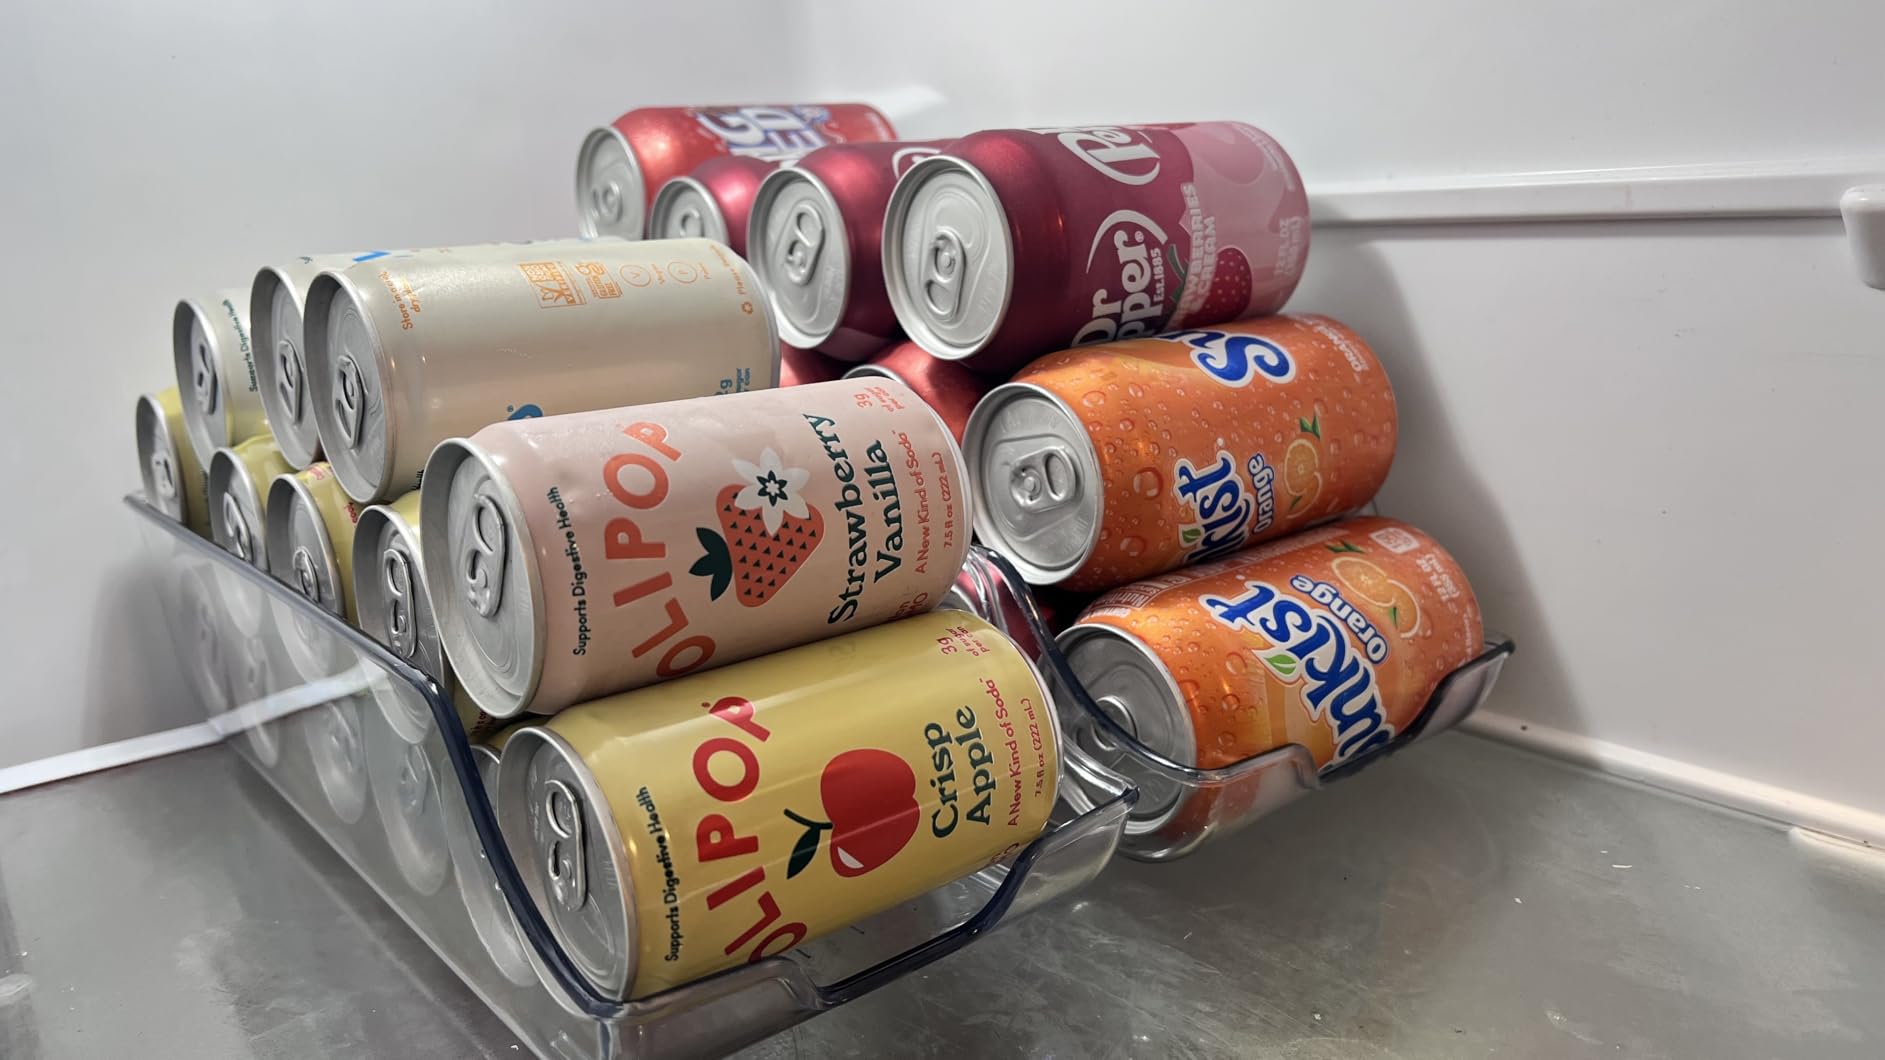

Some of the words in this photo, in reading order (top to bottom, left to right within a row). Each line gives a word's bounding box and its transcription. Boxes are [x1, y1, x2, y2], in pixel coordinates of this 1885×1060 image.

[1112, 230, 1164, 342] pper
[854, 393, 873, 409] 3g
[910, 470, 924, 487] of
[1248, 453, 1274, 533] Orange
[547, 486, 571, 530] Health
[803, 413, 868, 625] Strawberry
[864, 440, 904, 583] Vanilla
[914, 489, 930, 524] Kind
[1177, 453, 1252, 563] kist
[565, 531, 587, 597] Digestive
[602, 421, 716, 678] OLIPOP
[916, 527, 930, 562] New
[915, 562, 927, 573] A
[573, 599, 591, 656] Supports
[945, 628, 970, 647] sugar
[1291, 576, 1388, 663] Orange
[936, 637, 957, 655] 3g
[966, 647, 979, 656] of
[972, 639, 990, 653] per
[1201, 582, 1394, 758] unkist
[986, 679, 1008, 719] Soda
[1021, 698, 1035, 720] mL)
[1000, 722, 1014, 738] of
[1029, 722, 1042, 751] (222
[955, 705, 996, 825] Apple
[1005, 740, 1021, 778] Kind
[924, 721, 958, 838] Crisp
[1009, 780, 1021, 815] New
[1035, 780, 1044, 797] 7.5
[636, 787, 661, 835] Health
[1008, 815, 1019, 826] A
[657, 836, 680, 902] Digestive
[665, 906, 683, 962] Supports
